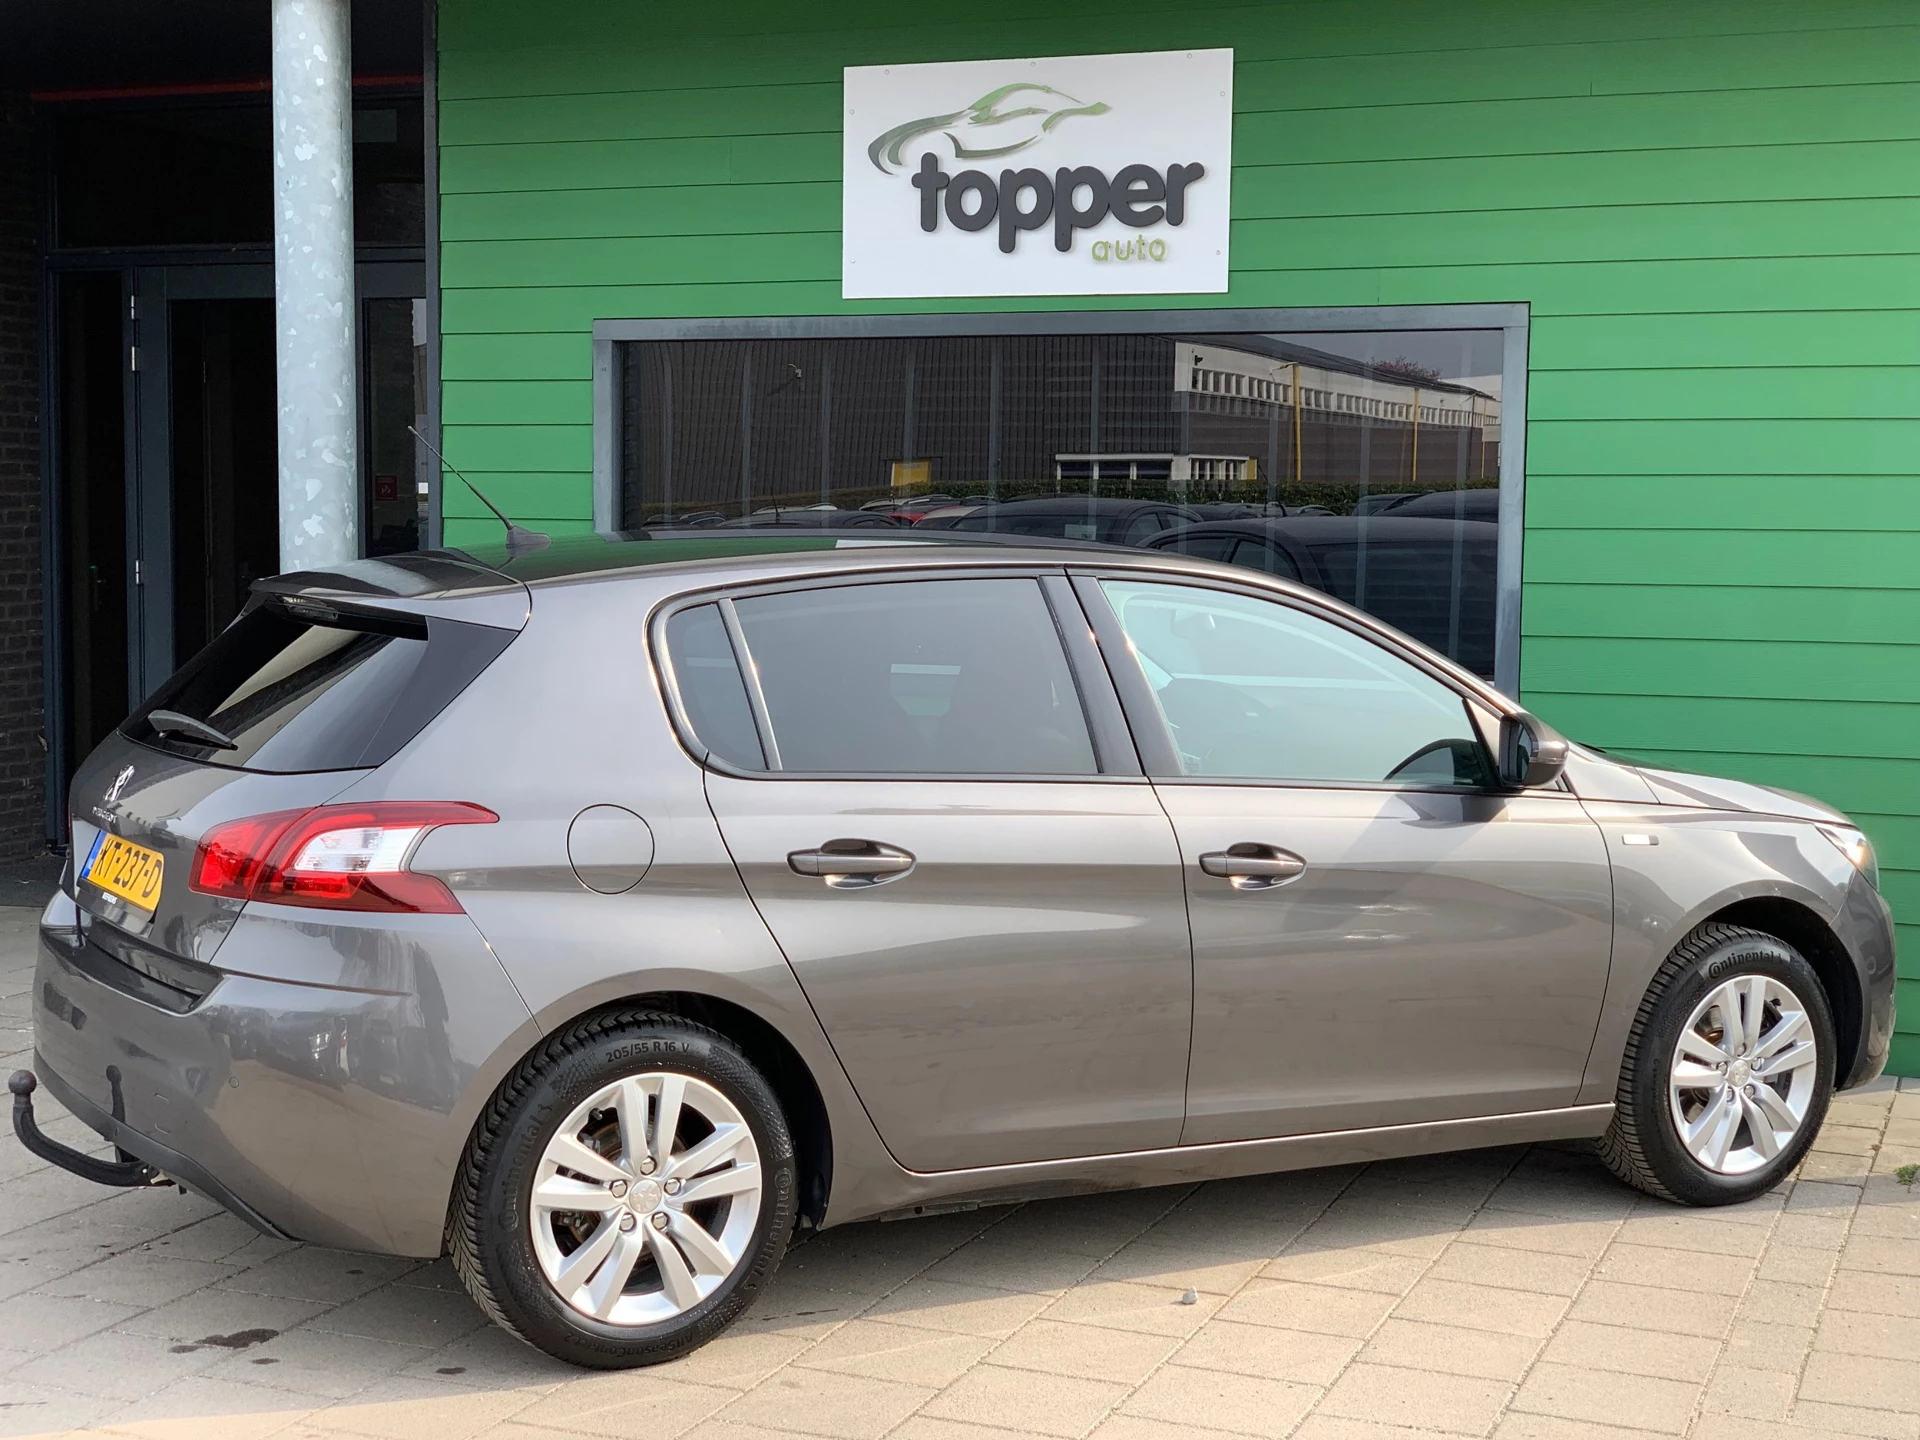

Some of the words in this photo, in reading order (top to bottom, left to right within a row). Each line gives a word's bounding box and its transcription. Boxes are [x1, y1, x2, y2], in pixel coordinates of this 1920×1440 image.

[911, 152, 1204, 253] topper
[1091, 234, 1167, 261] auto
[1708, 950, 1774, 979] Continental
[605, 1042, 649, 1063] 205/55
[653, 1041, 661, 1052] R
[663, 1041, 676, 1052] 16
[681, 1042, 690, 1053] V
